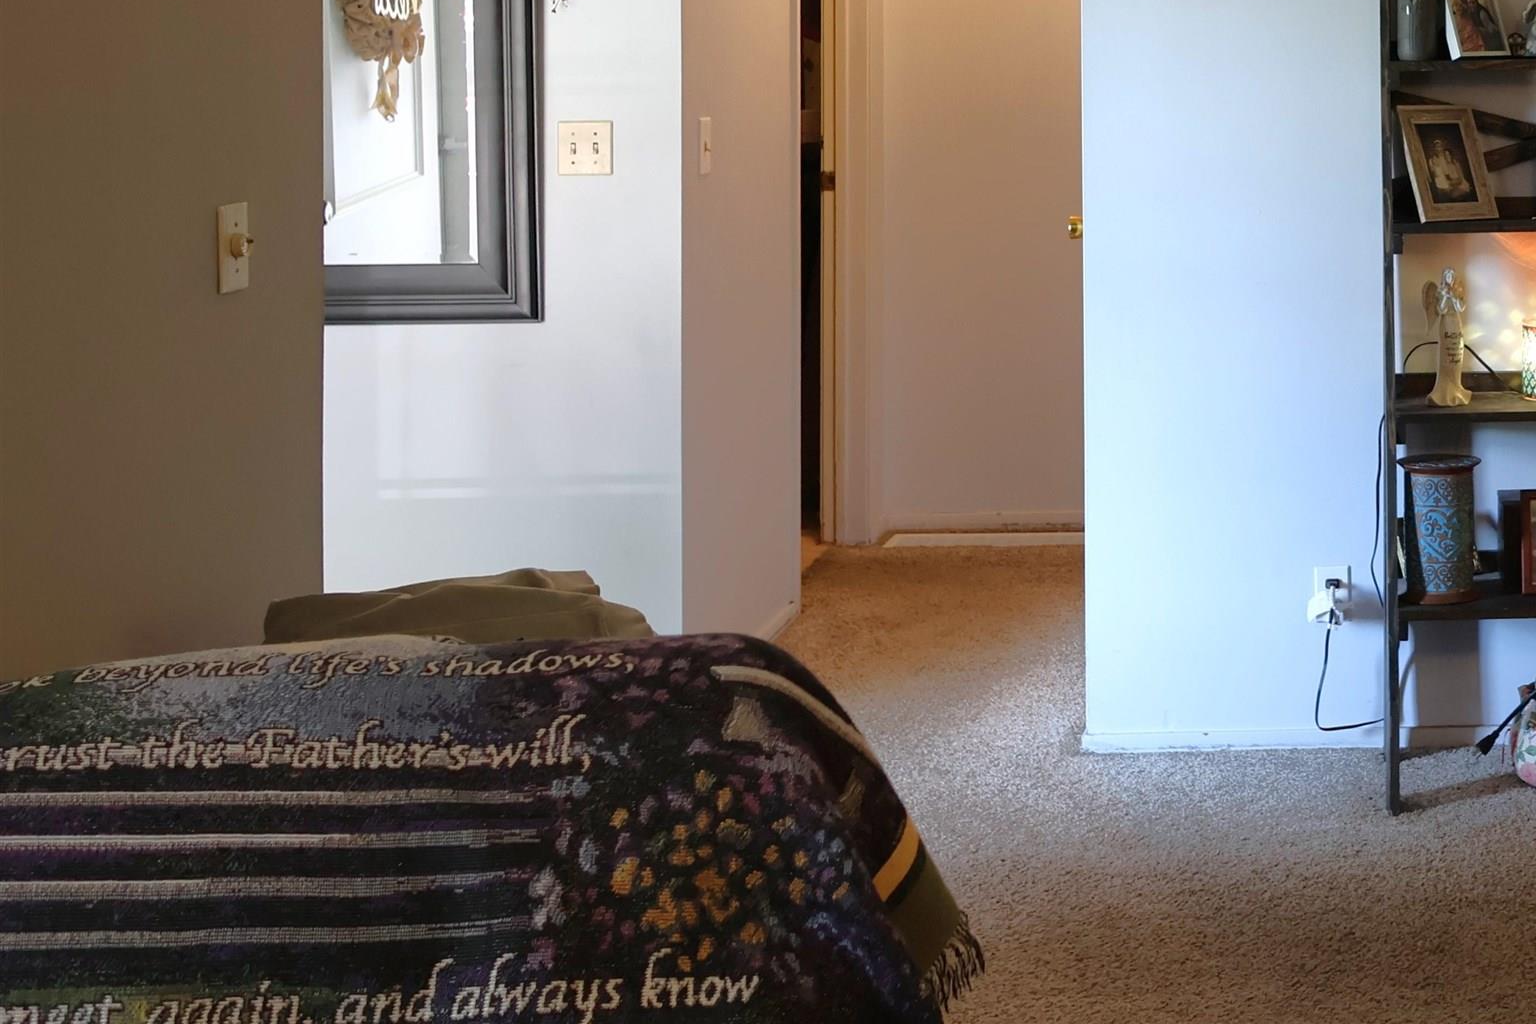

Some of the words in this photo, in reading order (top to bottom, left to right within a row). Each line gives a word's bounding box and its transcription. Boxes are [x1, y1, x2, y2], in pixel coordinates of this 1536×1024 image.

[73, 652, 284, 693] beyond
[288, 650, 405, 689] life's
[421, 649, 634, 676] shadows,
[141, 719, 223, 769] the
[249, 719, 470, 770] Father's
[486, 714, 592, 773] will,
[335, 958, 454, 1024] and
[451, 952, 625, 1024] always
[641, 948, 760, 1009] know
